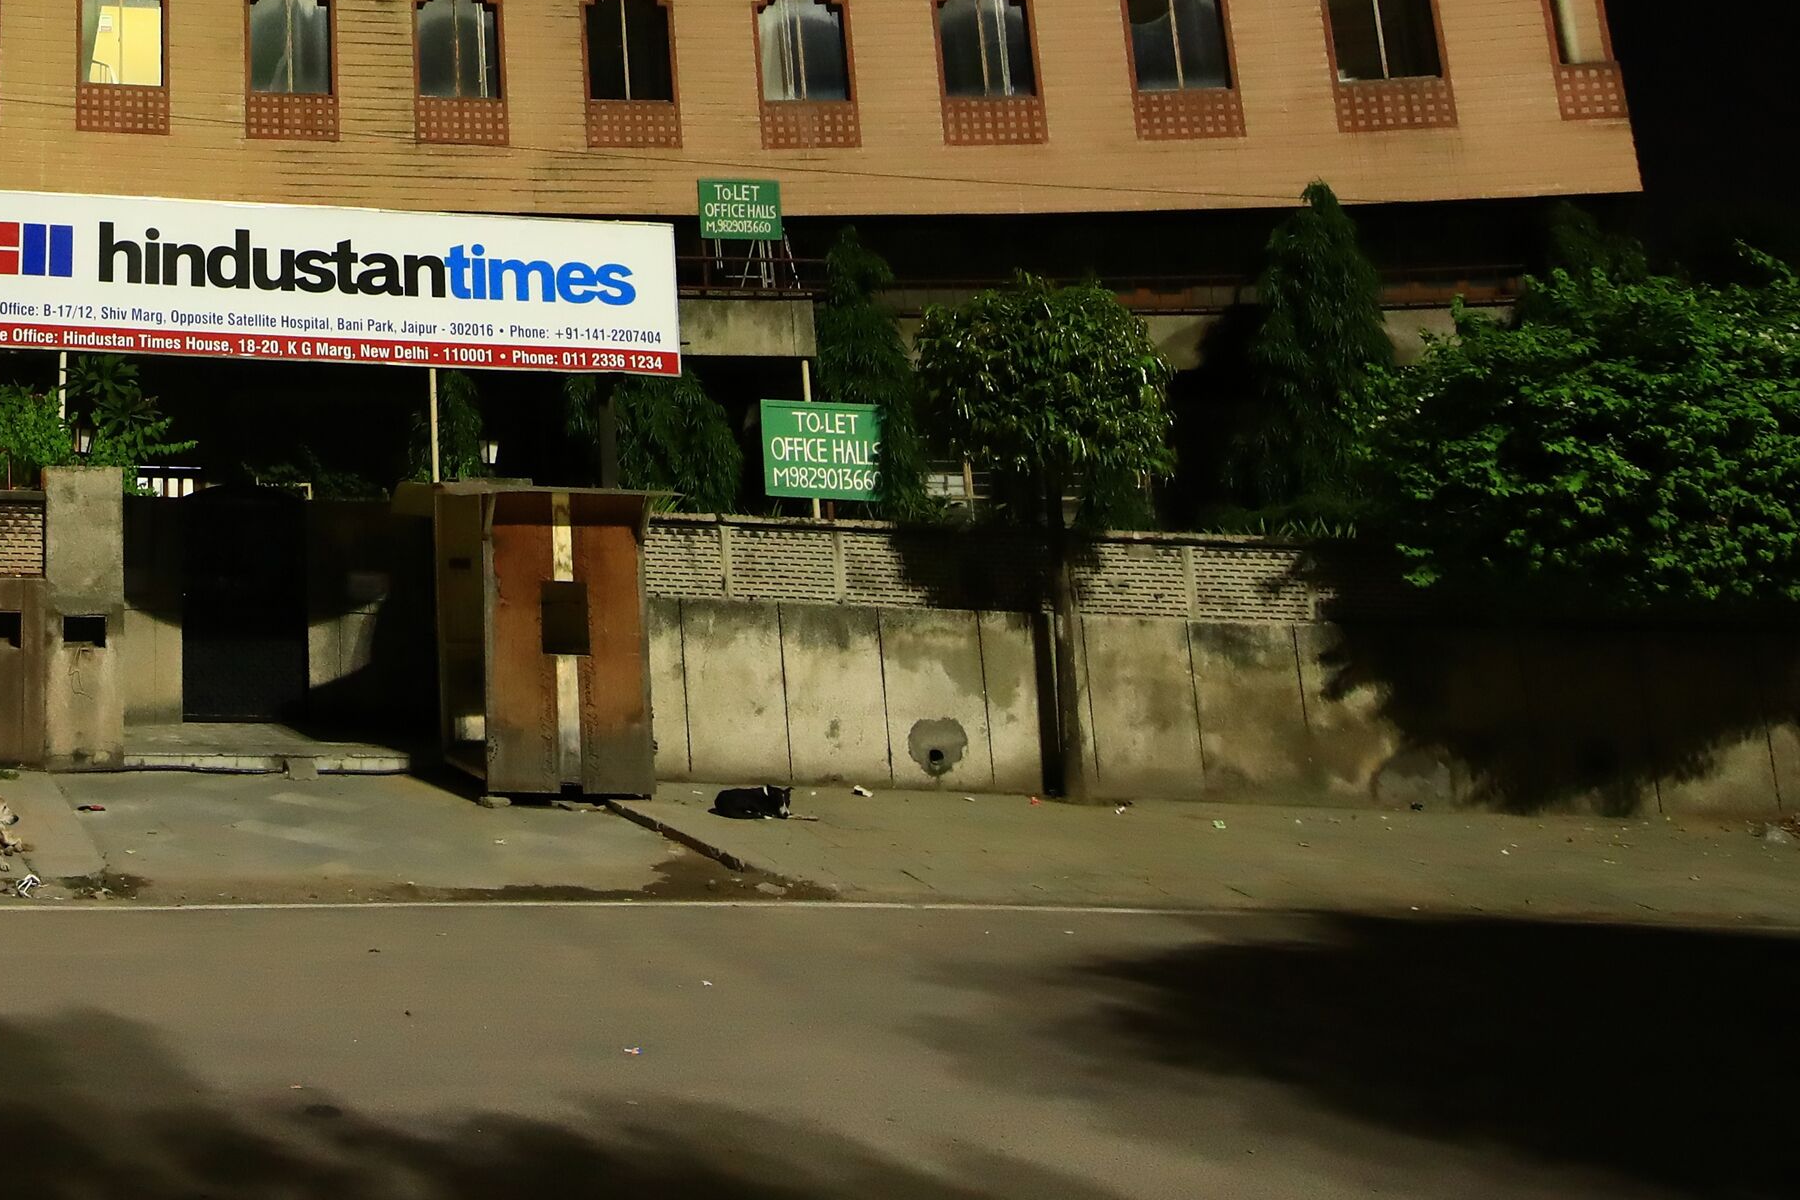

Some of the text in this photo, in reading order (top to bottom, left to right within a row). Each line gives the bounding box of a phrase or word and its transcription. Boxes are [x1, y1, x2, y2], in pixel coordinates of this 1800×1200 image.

[704, 203, 776, 219] OFFICE HALLS
[98, 221, 636, 306] hindustantimes
[0, 301, 38, 316] Office:
[43, 304, 97, 320] B-17/12,
[101, 307, 127, 320] Shiv
[131, 308, 166, 325] Marg,
[171, 310, 223, 326] Opposite
[228, 313, 276, 327] Satellite
[281, 315, 332, 331] Hospital,
[337, 318, 363, 331] Bani
[367, 319, 397, 333] Park,
[401, 320, 437, 336] Jaipur
[450, 323, 494, 337] 302016
[510, 325, 549, 339] Phone:
[555, 326, 662, 344] +91-141-2207404
[12, 328, 58, 343] Office:
[63, 331, 134, 347] Hindustan
[138, 334, 181, 349] Times
[185, 337, 234, 353] House,
[238, 339, 283, 356] 18-20,
[287, 341, 297, 354] K
[301, 342, 312, 356] G
[316, 342, 356, 360] Marg,
[360, 344, 390, 358] New
[394, 346, 428, 360] Delhi
[443, 347, 492, 362] 110001
[512, 350, 558, 365] Phone:
[562, 352, 586, 366] 011
[591, 353, 625, 368] 2336
[629, 355, 663, 370] 1234
[771, 437, 828, 463] OFFICE
